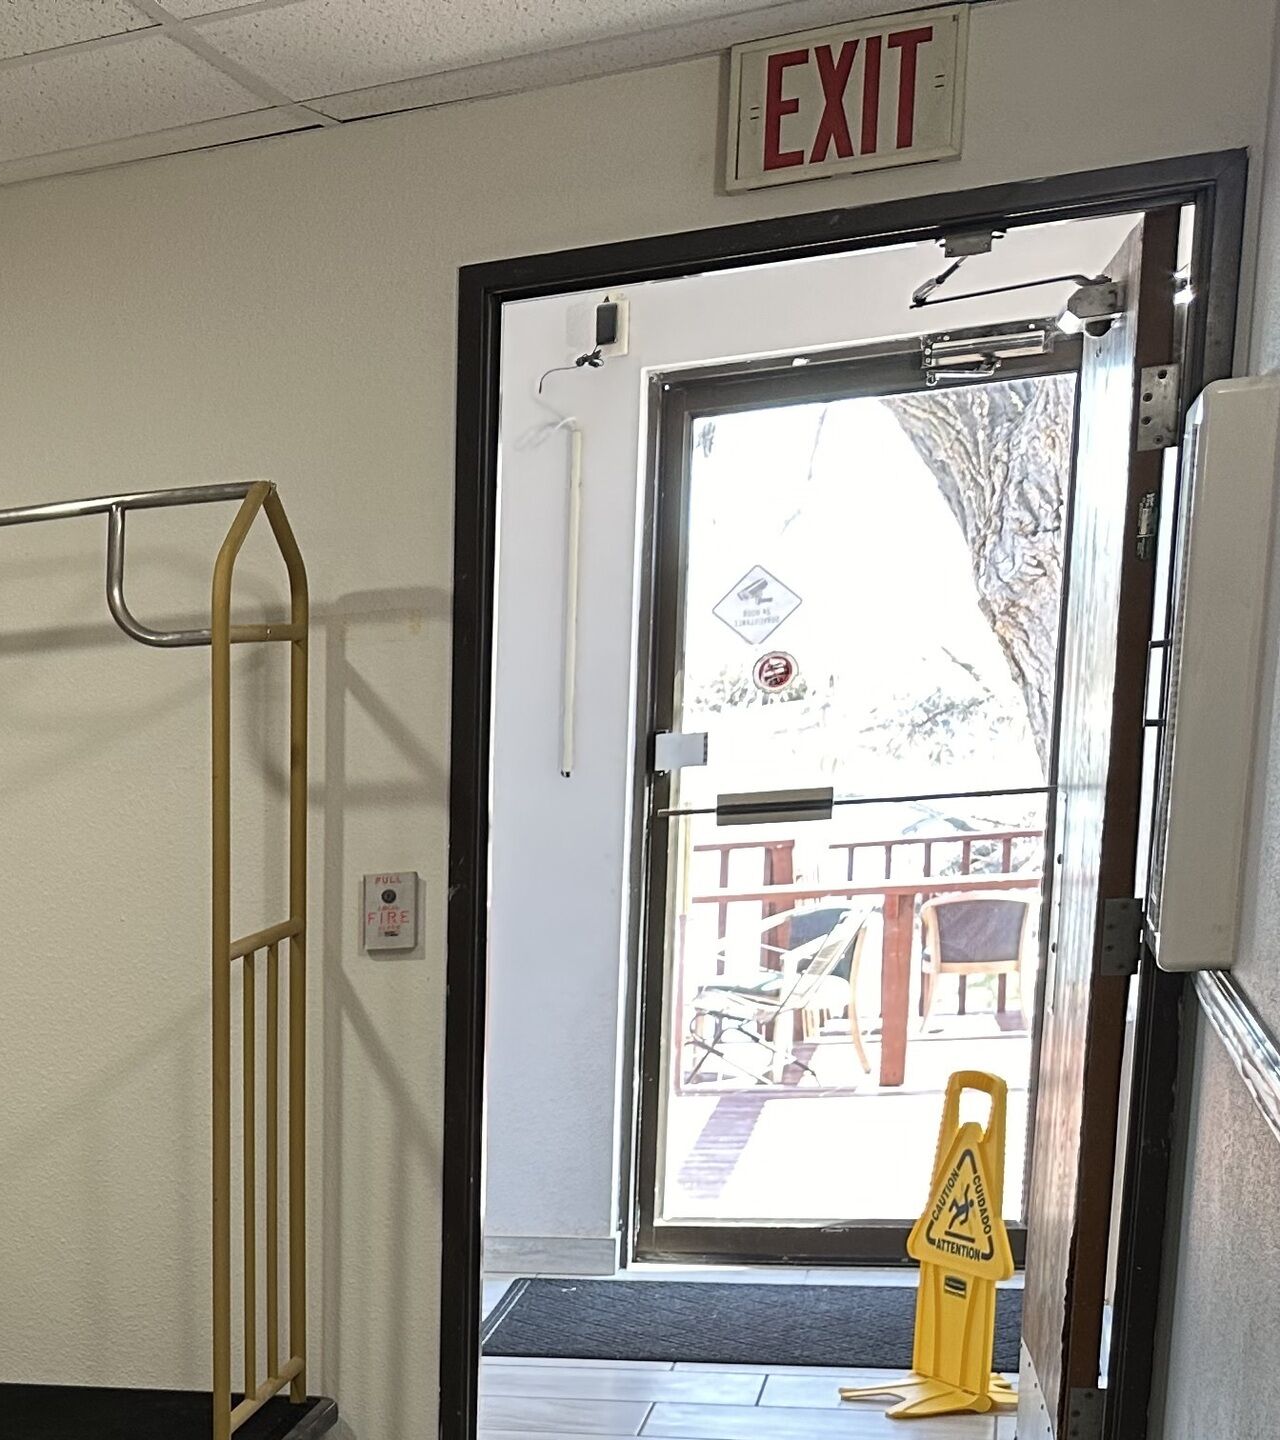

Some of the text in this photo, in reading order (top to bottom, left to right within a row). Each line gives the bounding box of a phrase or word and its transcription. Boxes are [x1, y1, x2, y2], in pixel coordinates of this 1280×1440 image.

[763, 26, 933, 171] EXIT
[375, 875, 402, 884] PULL
[367, 911, 409, 925] FIRE
[931, 1168, 959, 1221] CAUTION
[973, 1174, 992, 1235] CUIDADO
[936, 1238, 981, 1262] ATTENTION
